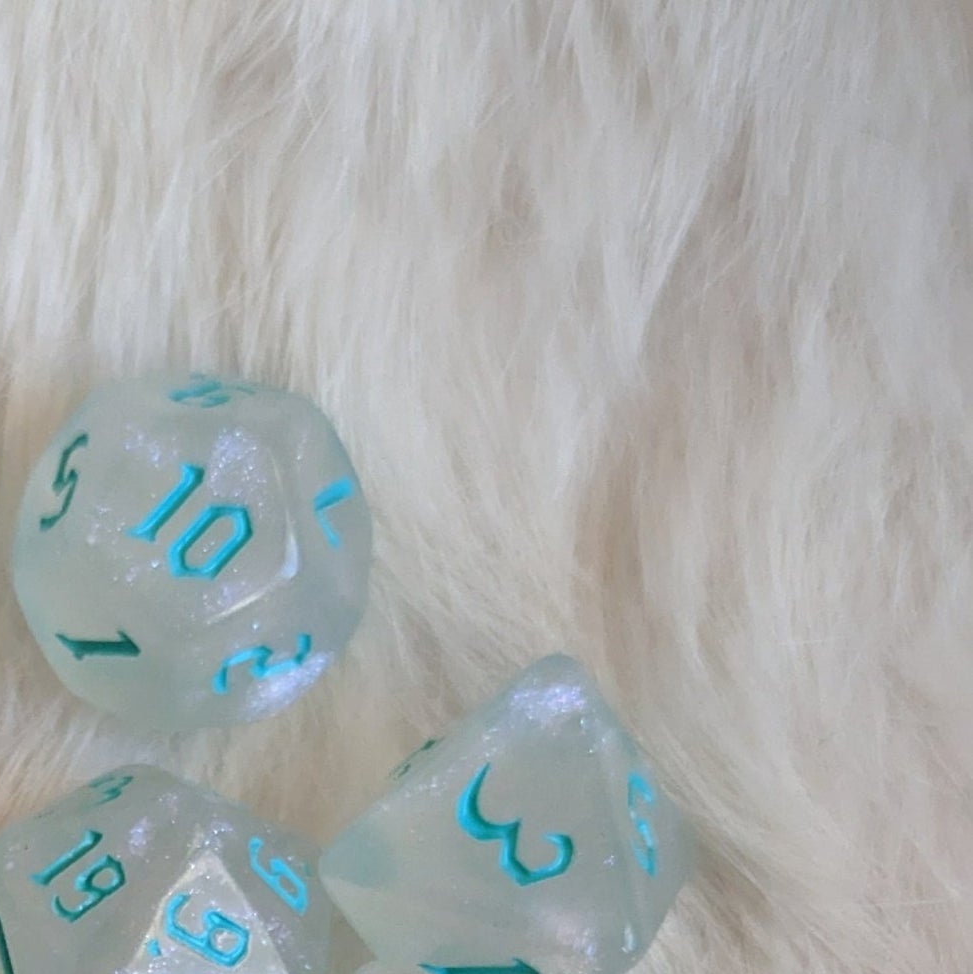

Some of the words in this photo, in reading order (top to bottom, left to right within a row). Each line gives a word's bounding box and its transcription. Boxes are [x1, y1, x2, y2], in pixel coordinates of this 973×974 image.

[39, 432, 89, 532] 5
[126, 461, 254, 581] 10
[54, 629, 142, 661] 1
[212, 631, 314, 696] 2
[454, 760, 576, 888] 3
[29, 828, 126, 923] 19
